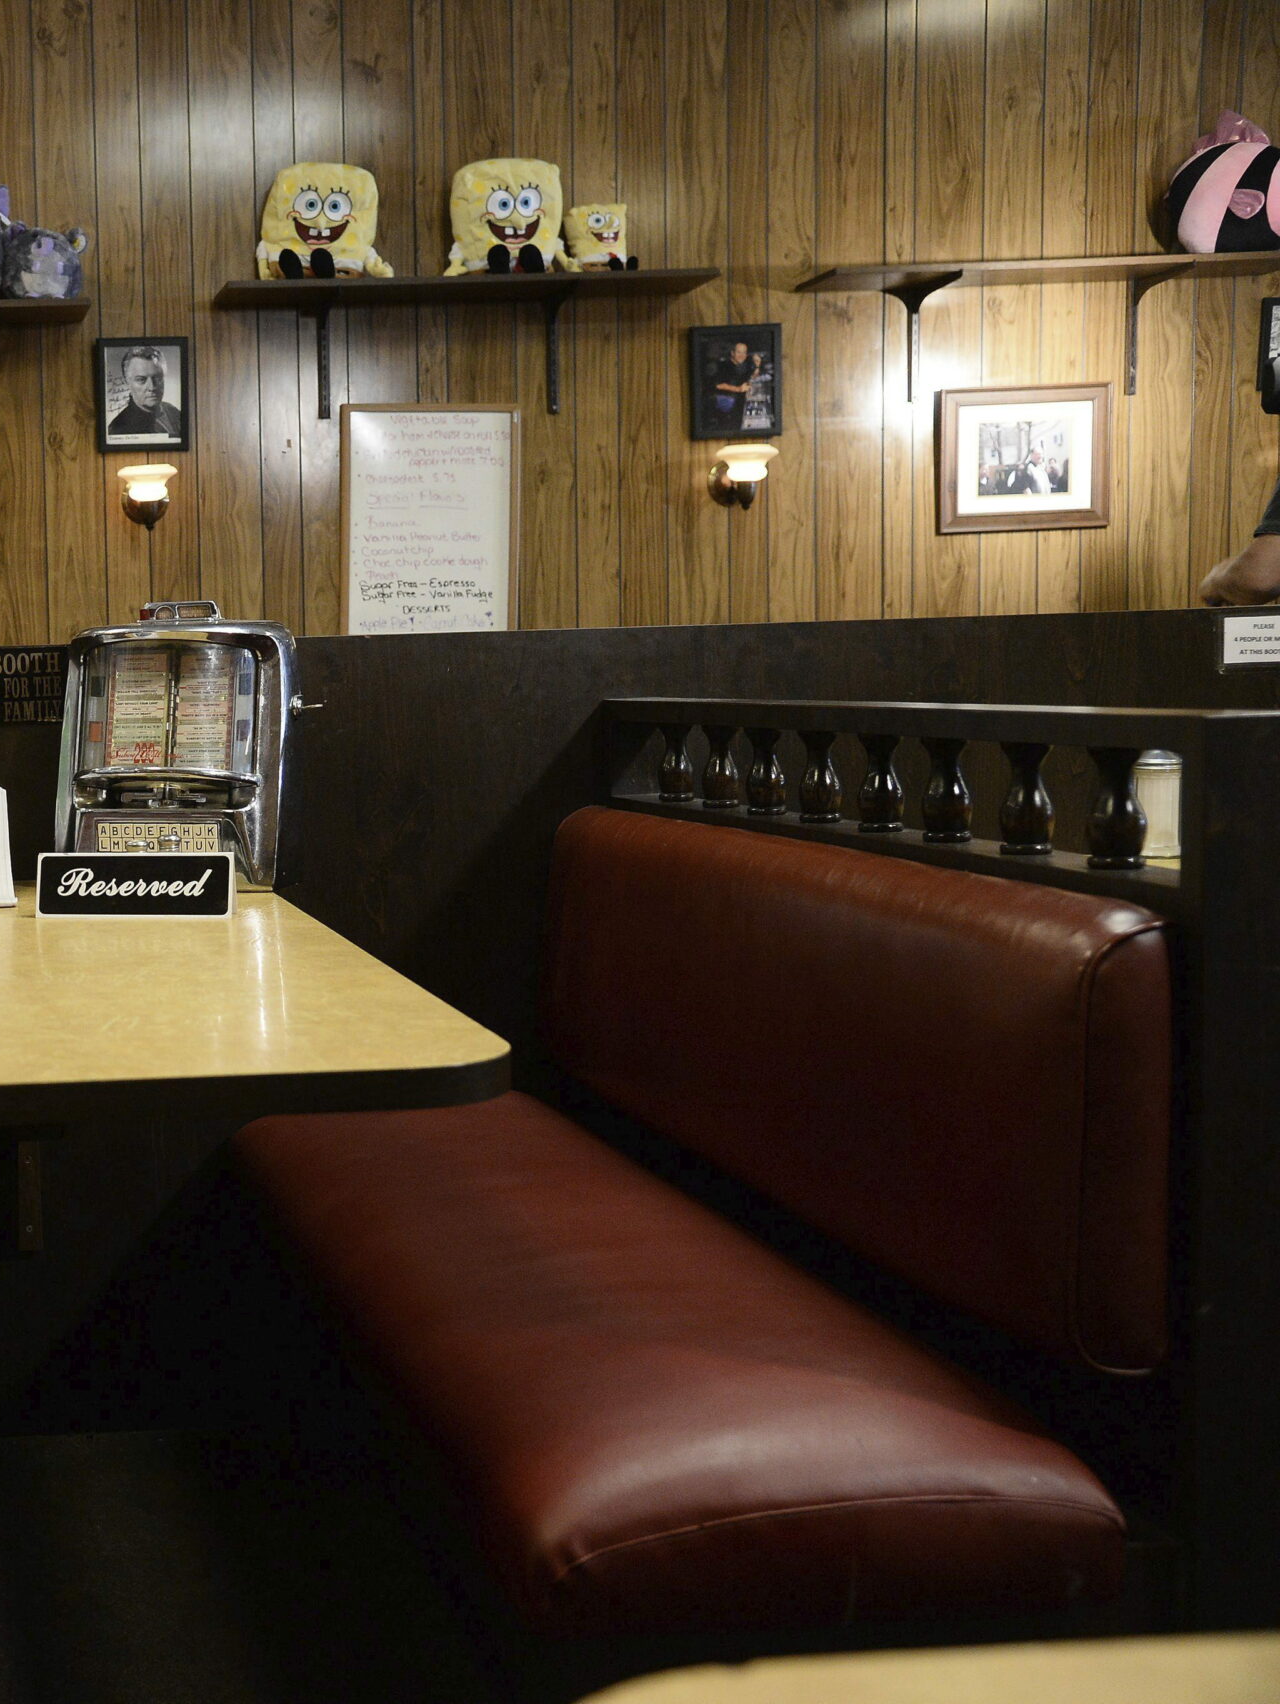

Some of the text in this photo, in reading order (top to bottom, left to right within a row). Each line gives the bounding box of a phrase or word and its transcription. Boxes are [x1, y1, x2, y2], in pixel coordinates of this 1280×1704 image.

[428, 577, 476, 588] Espresso
[396, 590, 417, 599] Free
[466, 588, 494, 603] Fudge
[402, 604, 451, 615] DESSERTS
[3, 676, 30, 699] FOR
[33, 675, 61, 698] THE
[4, 700, 61, 722] FAMILY
[57, 867, 213, 897] Reserved
